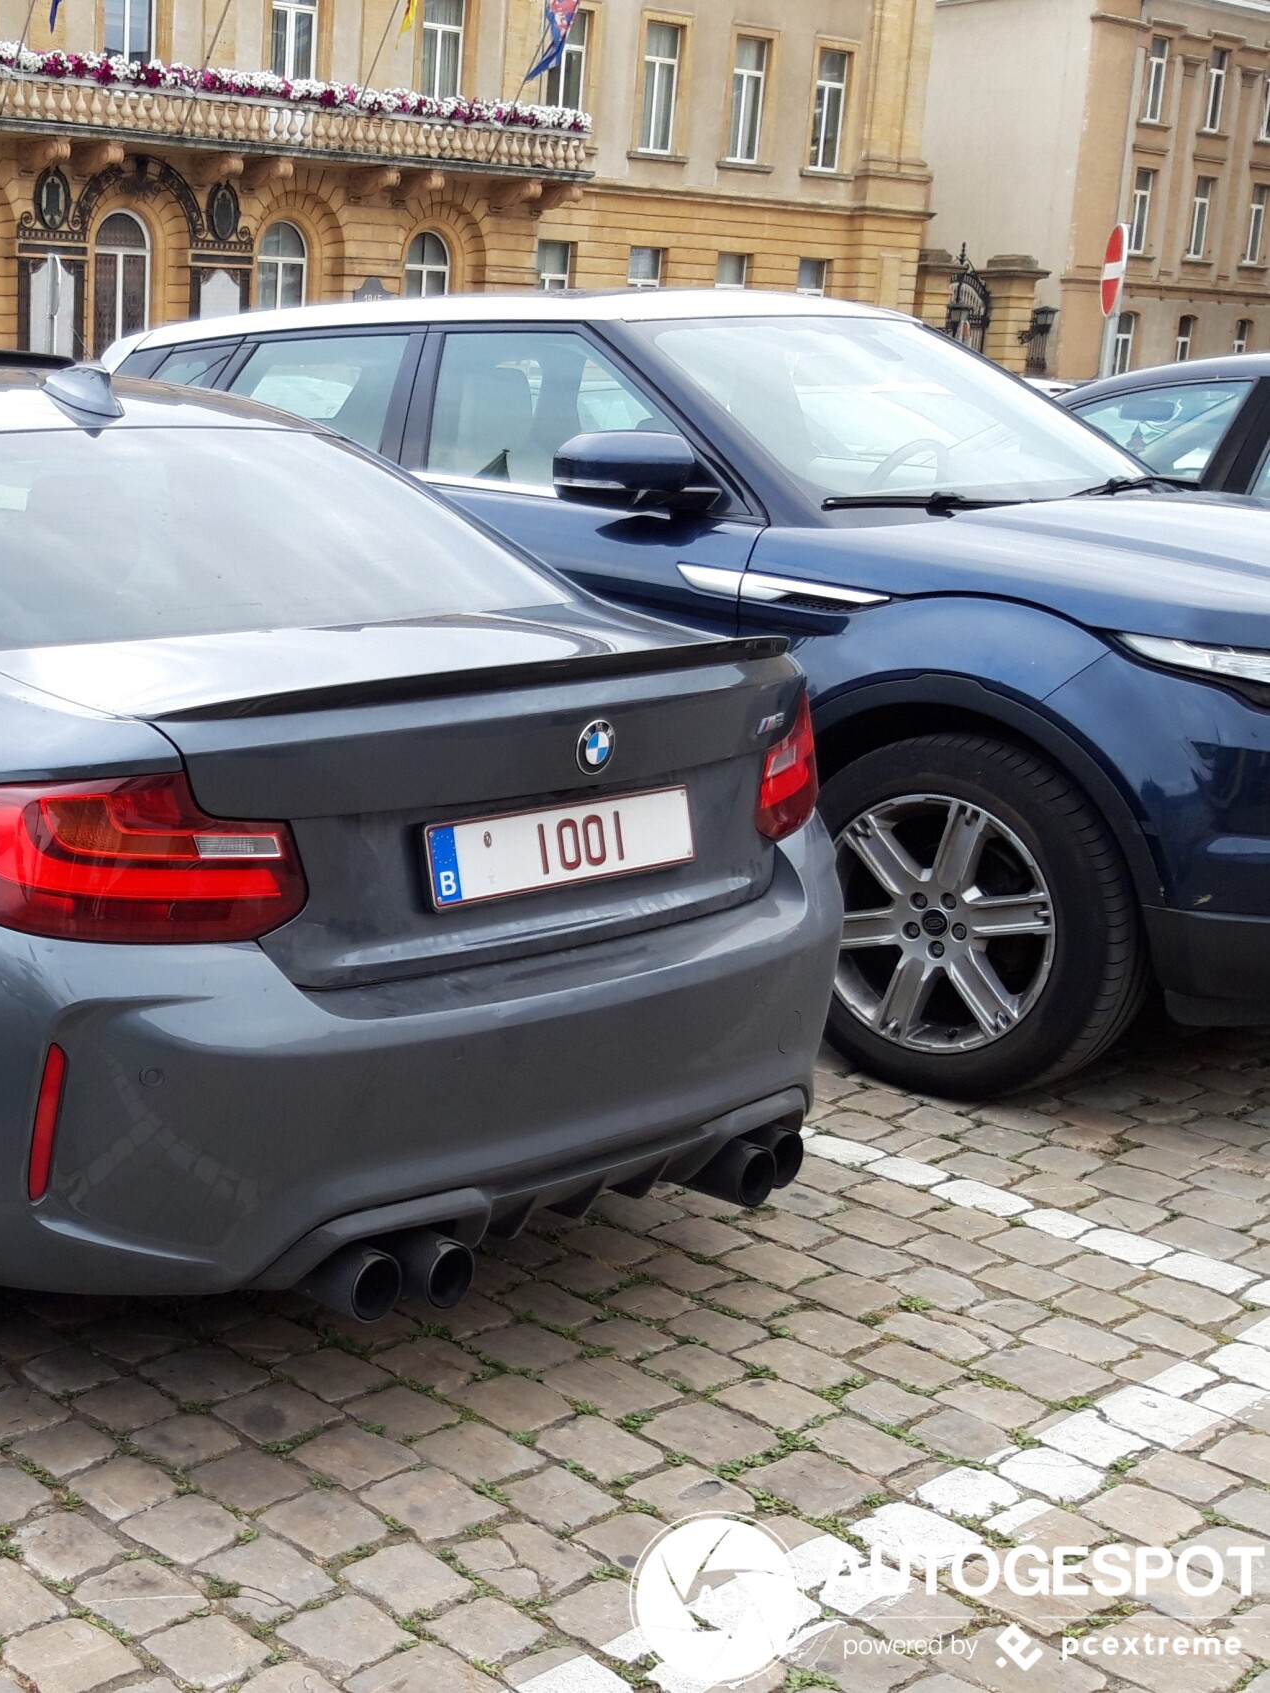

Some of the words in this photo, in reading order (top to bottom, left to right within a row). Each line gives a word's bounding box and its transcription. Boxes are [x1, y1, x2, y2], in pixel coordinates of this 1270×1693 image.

[582, 722, 614, 742] BMW
[537, 810, 625, 875] 1001
[440, 870, 457, 896] B
